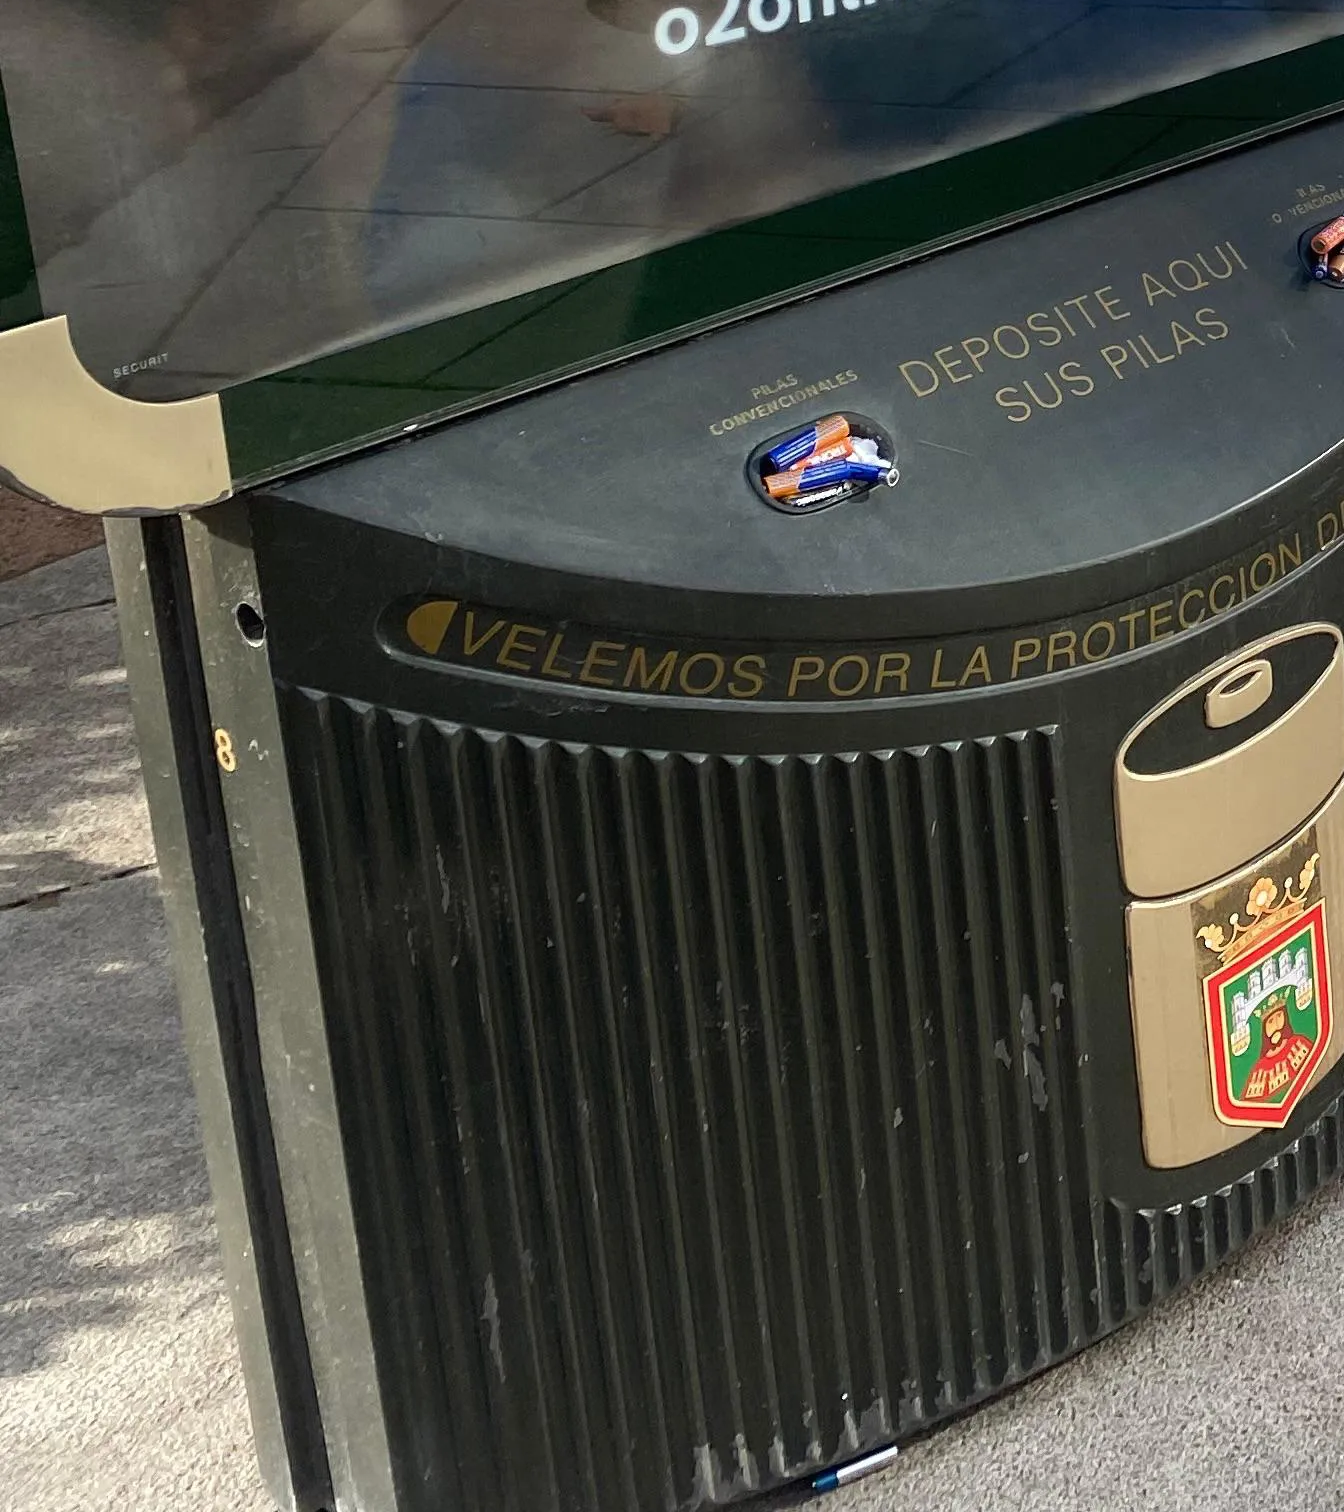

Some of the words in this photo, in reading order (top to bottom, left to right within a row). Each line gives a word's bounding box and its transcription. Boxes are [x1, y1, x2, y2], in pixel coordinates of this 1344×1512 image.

[898, 286, 1132, 398] DEPOSITE
[1141, 240, 1248, 307] AQUI
[995, 361, 1095, 423] SUS
[1101, 307, 1230, 381] PILAS
[112, 352, 170, 379] SECURIT
[709, 369, 859, 437] CONVENCIONALES
[751, 373, 799, 400] PILAS
[463, 610, 767, 698] VELEMOS
[788, 653, 912, 698] POR
[930, 645, 992, 689] LA
[1010, 532, 1303, 680] PROTECCION
